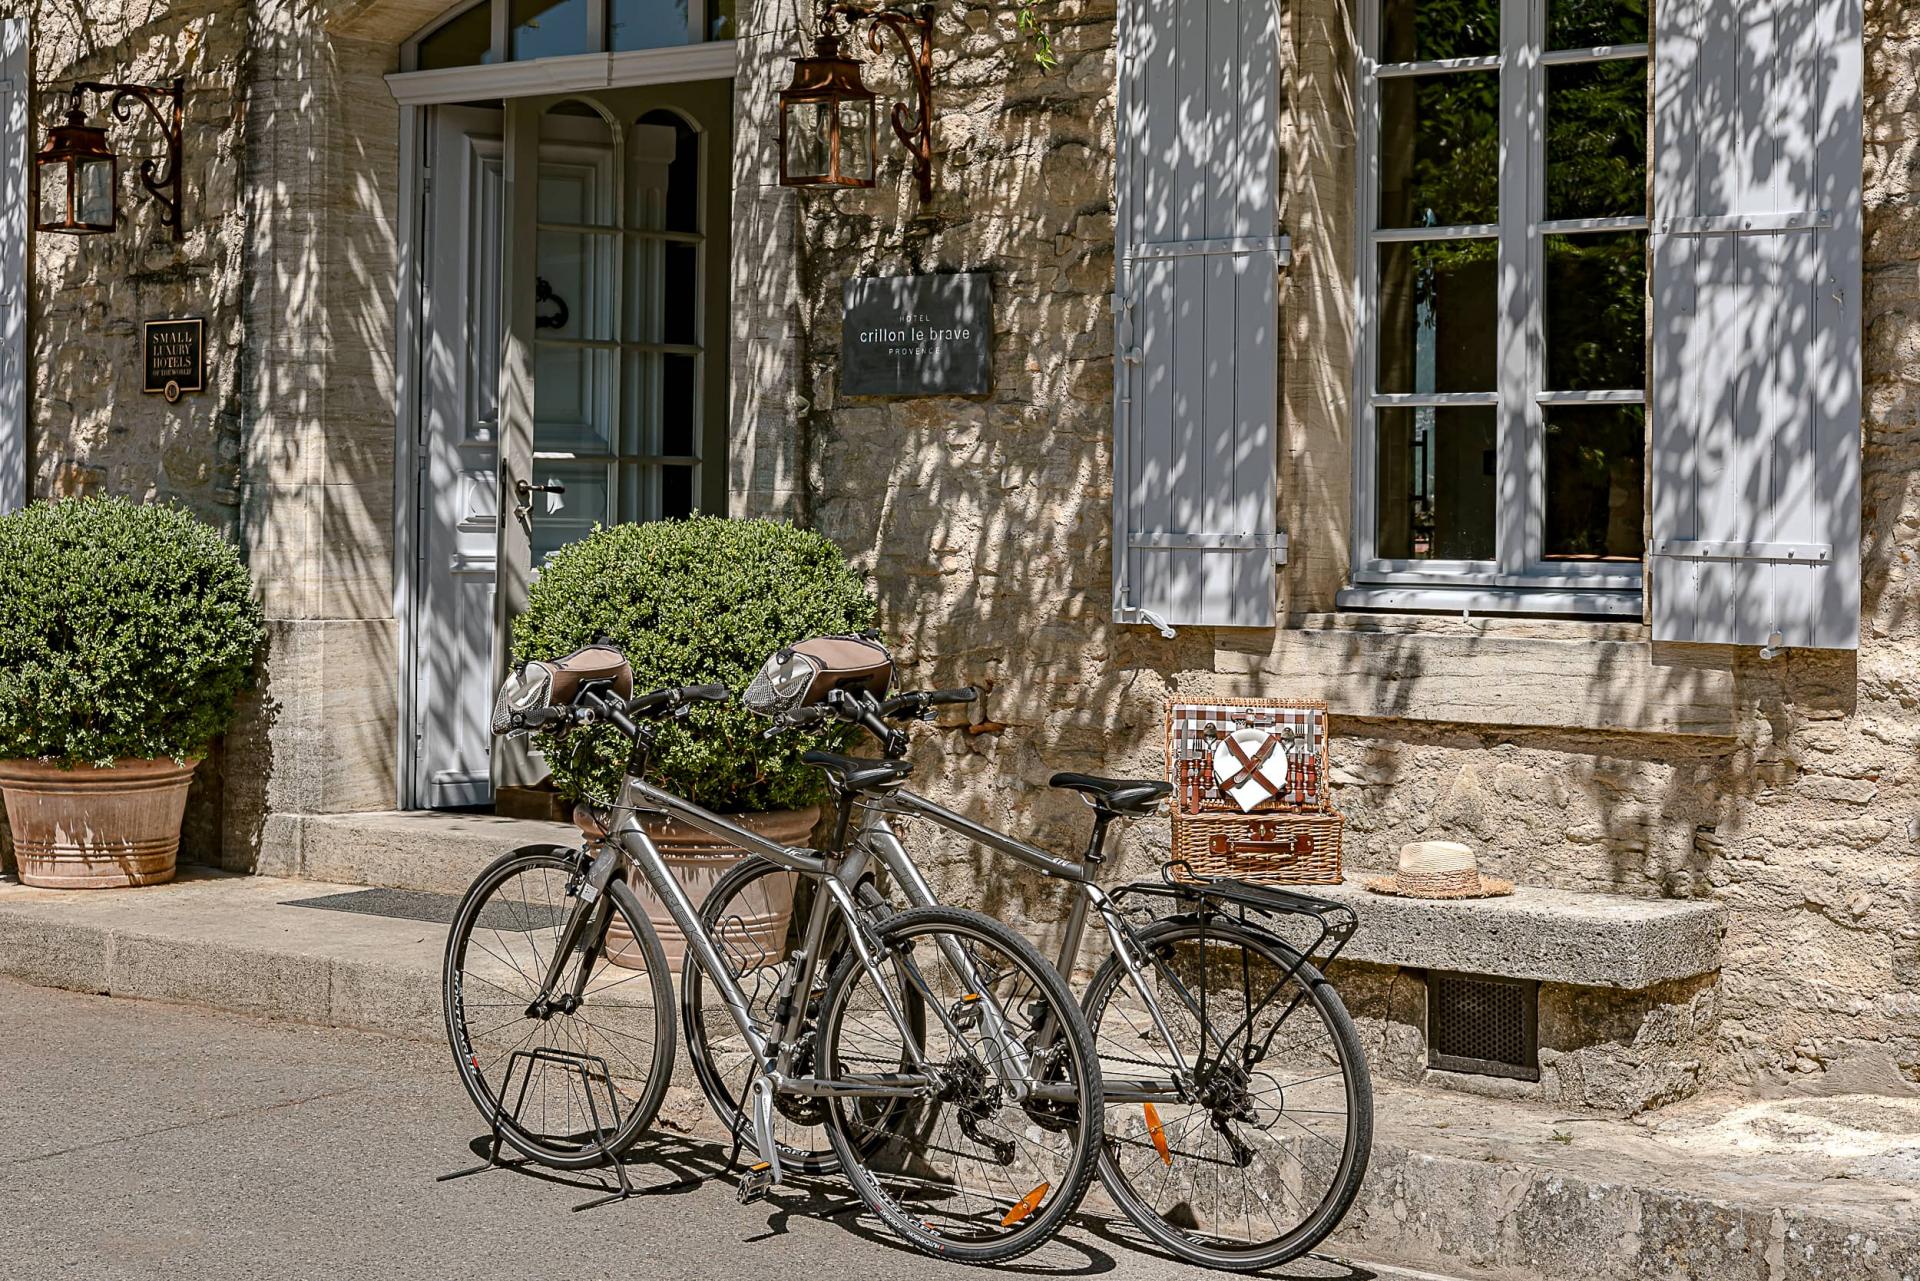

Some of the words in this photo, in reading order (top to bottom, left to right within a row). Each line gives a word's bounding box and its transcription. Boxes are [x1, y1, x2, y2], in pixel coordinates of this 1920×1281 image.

[900, 314, 931, 322] HOTEL
[153, 332, 192, 344] SMALL
[860, 328, 905, 343] crillon
[911, 327, 924, 341] le
[929, 327, 970, 340] brave
[153, 344, 192, 356] LUXURY
[888, 346, 941, 356] PROVENCE
[153, 356, 192, 368] HOTELS
[650, 862, 706, 946] TREK
[454, 969, 477, 1075] BONTRAGER
